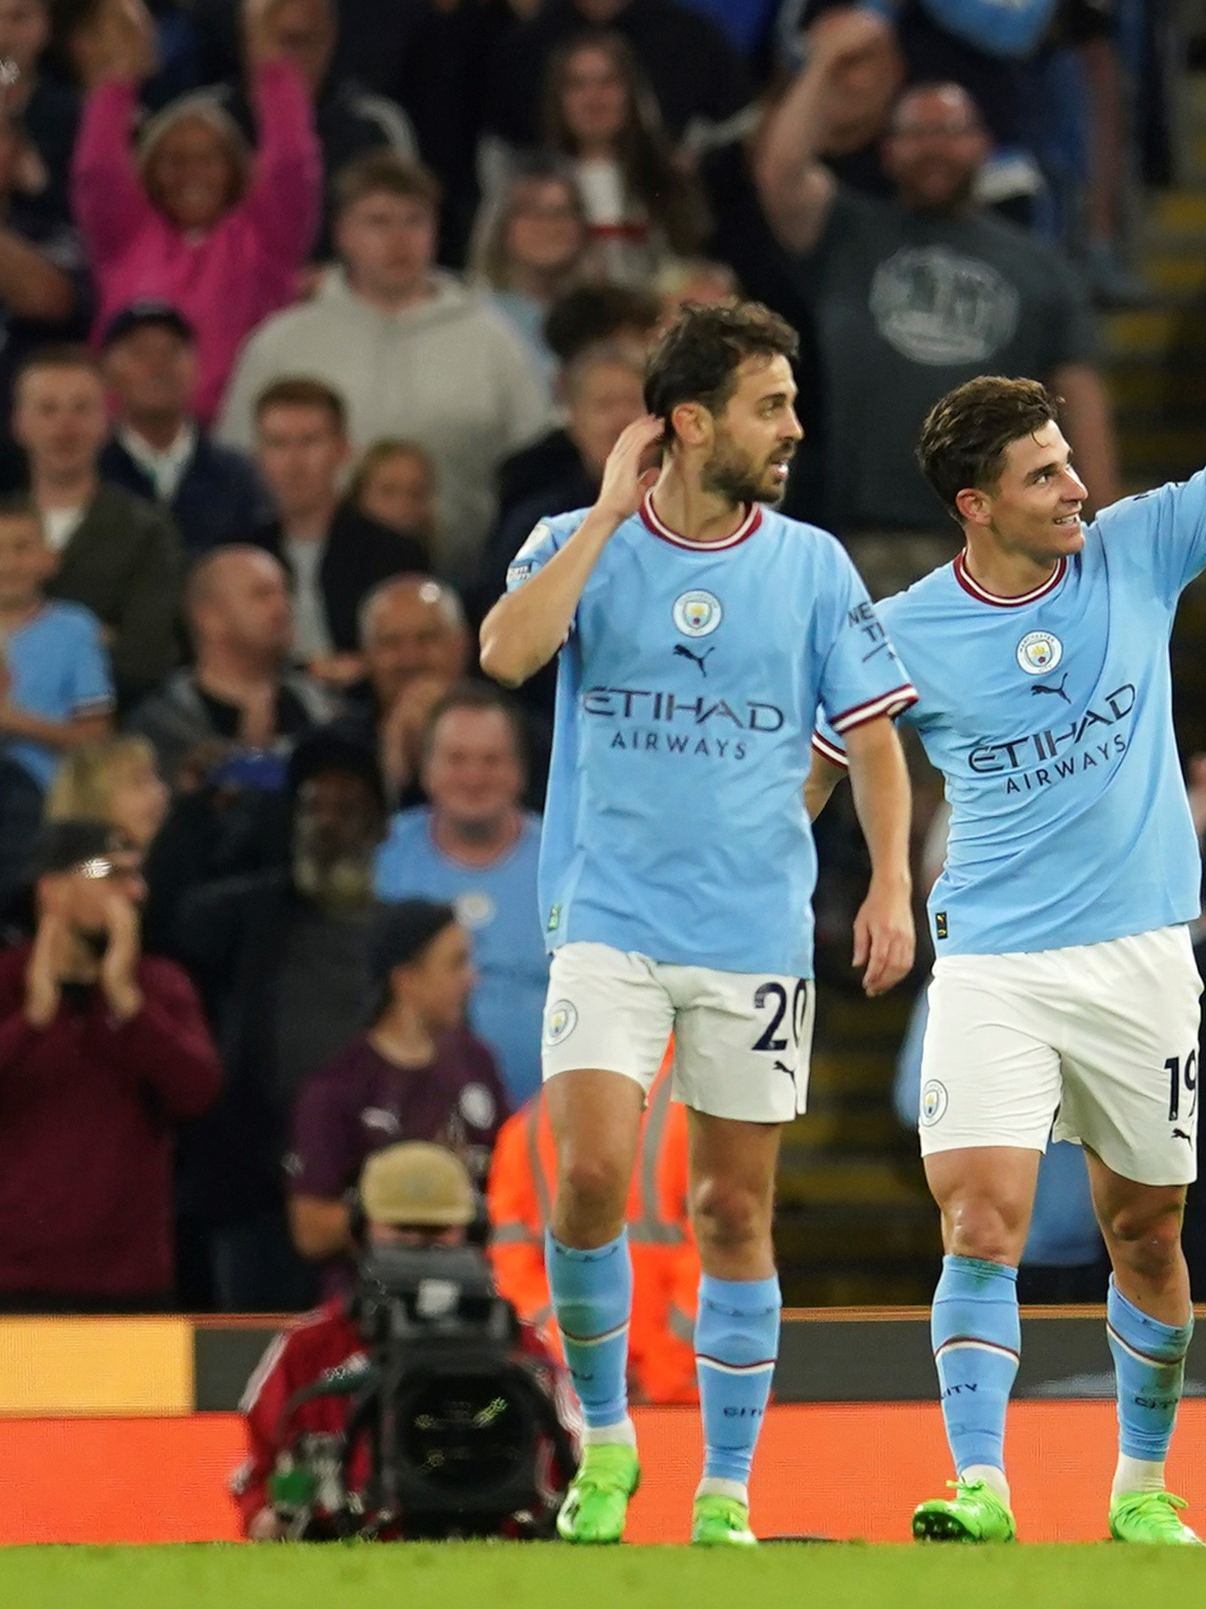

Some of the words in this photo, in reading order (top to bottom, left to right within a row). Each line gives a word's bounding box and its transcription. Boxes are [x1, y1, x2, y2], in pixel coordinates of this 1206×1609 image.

[582, 686, 785, 733] ETIHAD
[967, 683, 1137, 774] ETIHAD
[611, 731, 748, 761] AIRWAYS
[1005, 733, 1127, 795] AIRWAYS
[1164, 1049, 1197, 1121] 19
